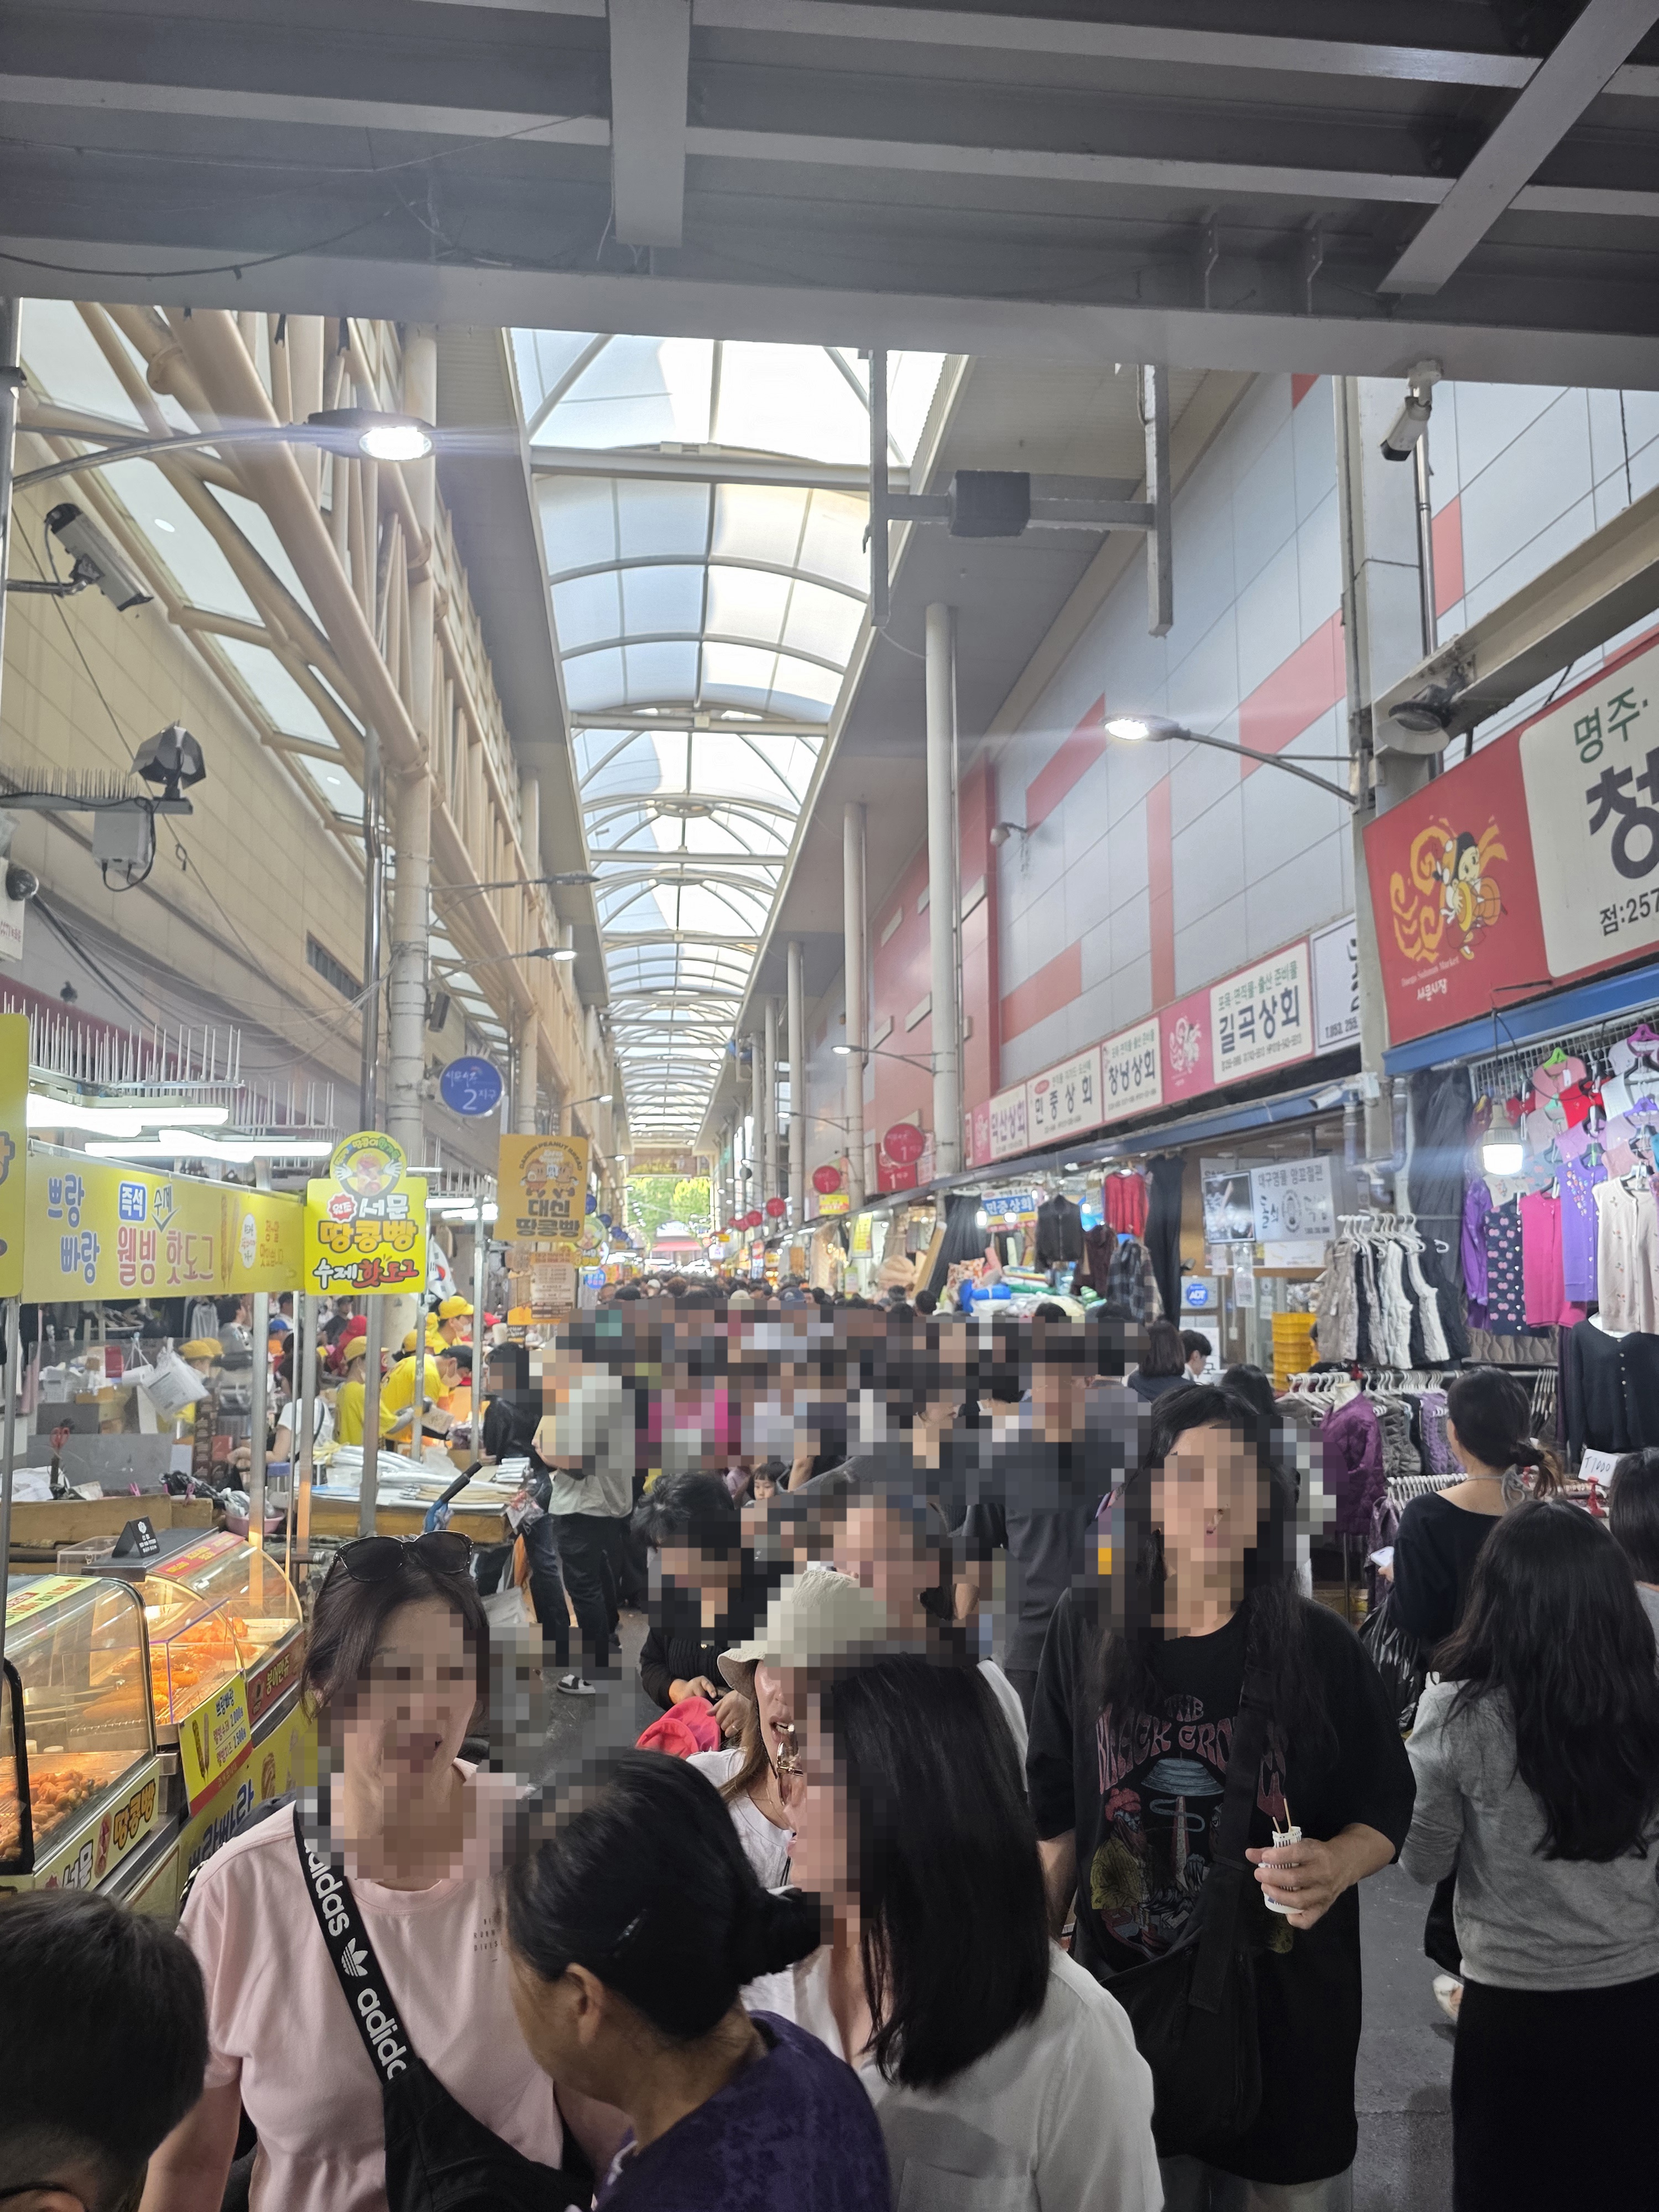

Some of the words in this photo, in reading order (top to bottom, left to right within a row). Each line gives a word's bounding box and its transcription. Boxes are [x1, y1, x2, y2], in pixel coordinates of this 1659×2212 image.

[1219, 984, 1300, 1055] 길곡상회
[1109, 1048, 1156, 1097] 창녕상회
[462, 1088, 497, 1110] 2지구
[538, 1141, 568, 1151] PEANUT
[48, 1173, 85, 1228] 쁘랑
[122, 1186, 144, 1218] 즉석
[154, 1185, 173, 1217] 수제
[332, 1202, 353, 1214] 원조
[359, 1193, 409, 1220] 서문
[528, 1199, 570, 1218] 대신
[985, 1197, 1034, 1215] 민중상회
[318, 1220, 419, 1253] 땅콩빵
[515, 1218, 581, 1238] 땅콩빵
[60, 1231, 100, 1284] 빠랑
[118, 1226, 156, 1286] 웰빙
[166, 1229, 214, 1285] 핫도그
[313, 1258, 358, 1290] 수제
[352, 1257, 420, 1288] 핫도그
[1189, 1290, 1206, 1300] ADT
[266, 1653, 290, 1695] 붕어만쥬
[216, 1687, 234, 1717] 쁘랑빠랑
[113, 1777, 156, 1850] 땅콩빵
[62, 1839, 94, 1889] 서문
[304, 1839, 350, 1937] didas
